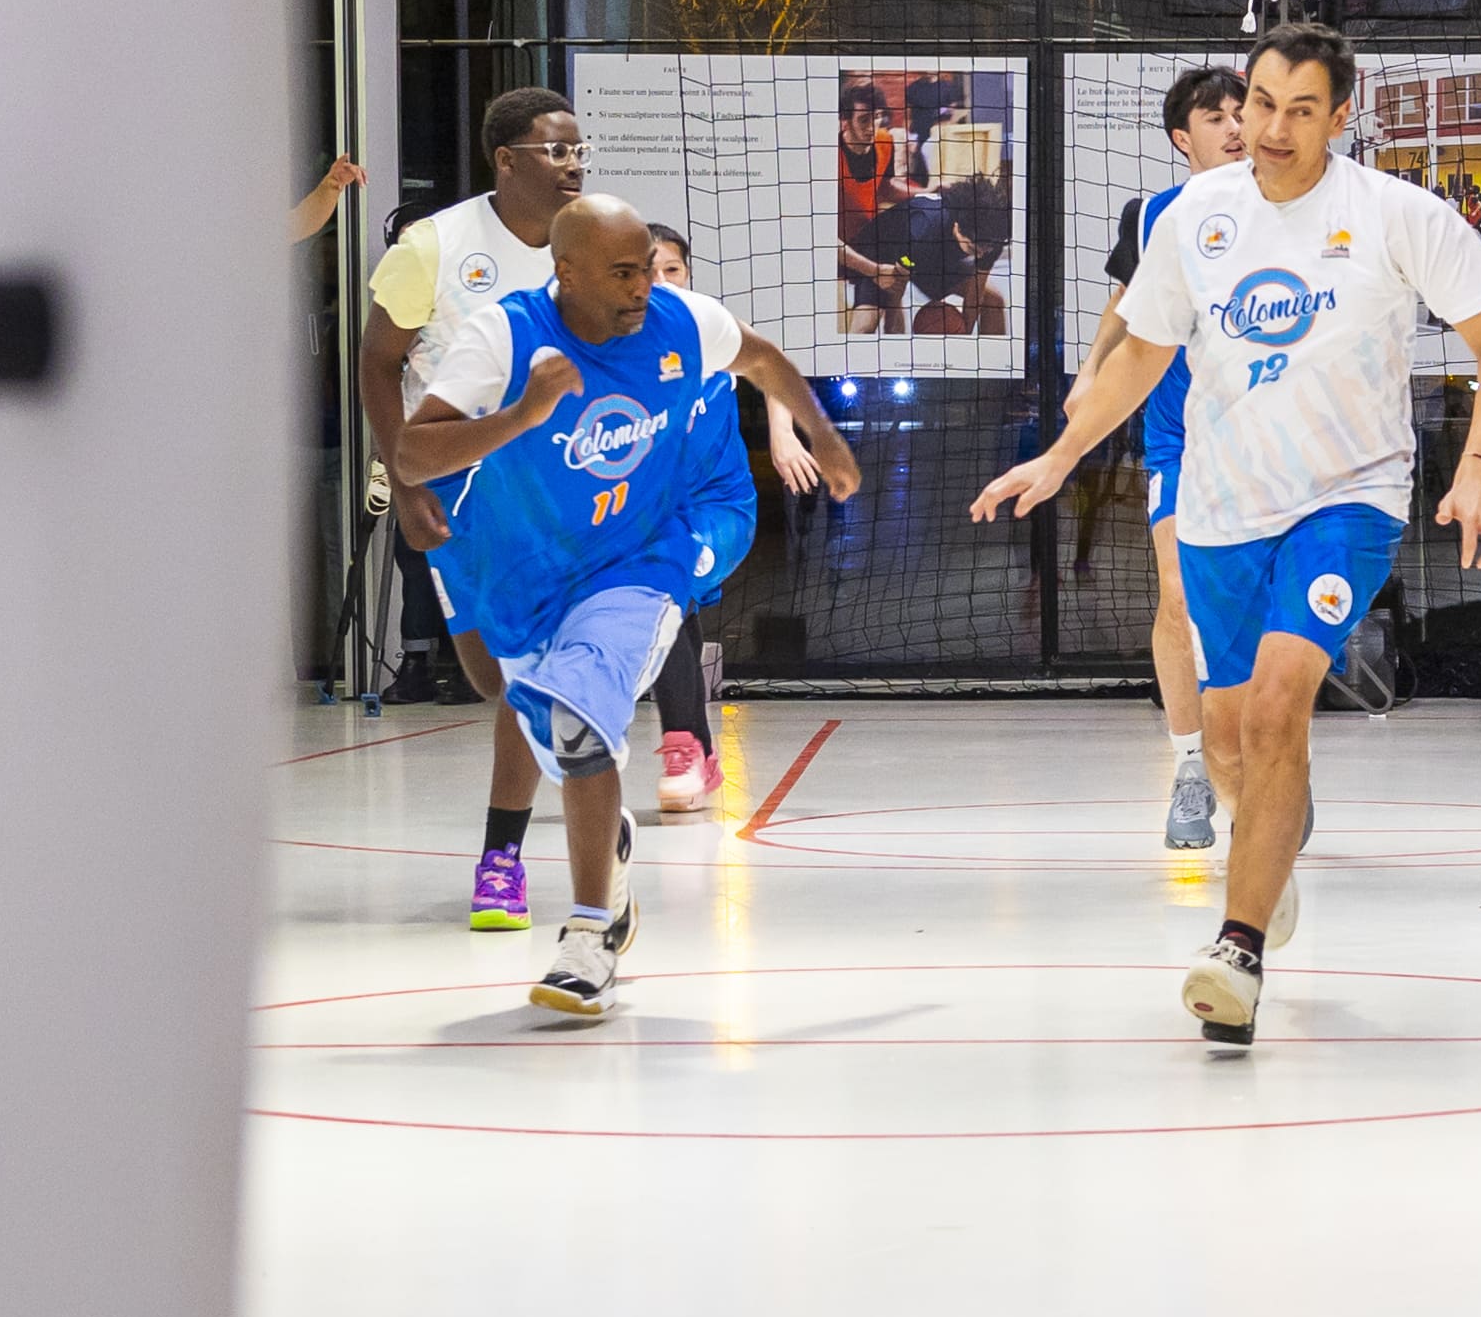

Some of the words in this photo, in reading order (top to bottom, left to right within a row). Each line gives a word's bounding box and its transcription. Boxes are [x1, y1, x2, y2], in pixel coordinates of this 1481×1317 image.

[707, 89, 753, 97] l'adversare.
[1209, 287, 1336, 340] Colomiers
[551, 408, 668, 470] Colomiers
[591, 481, 630, 526] 11
